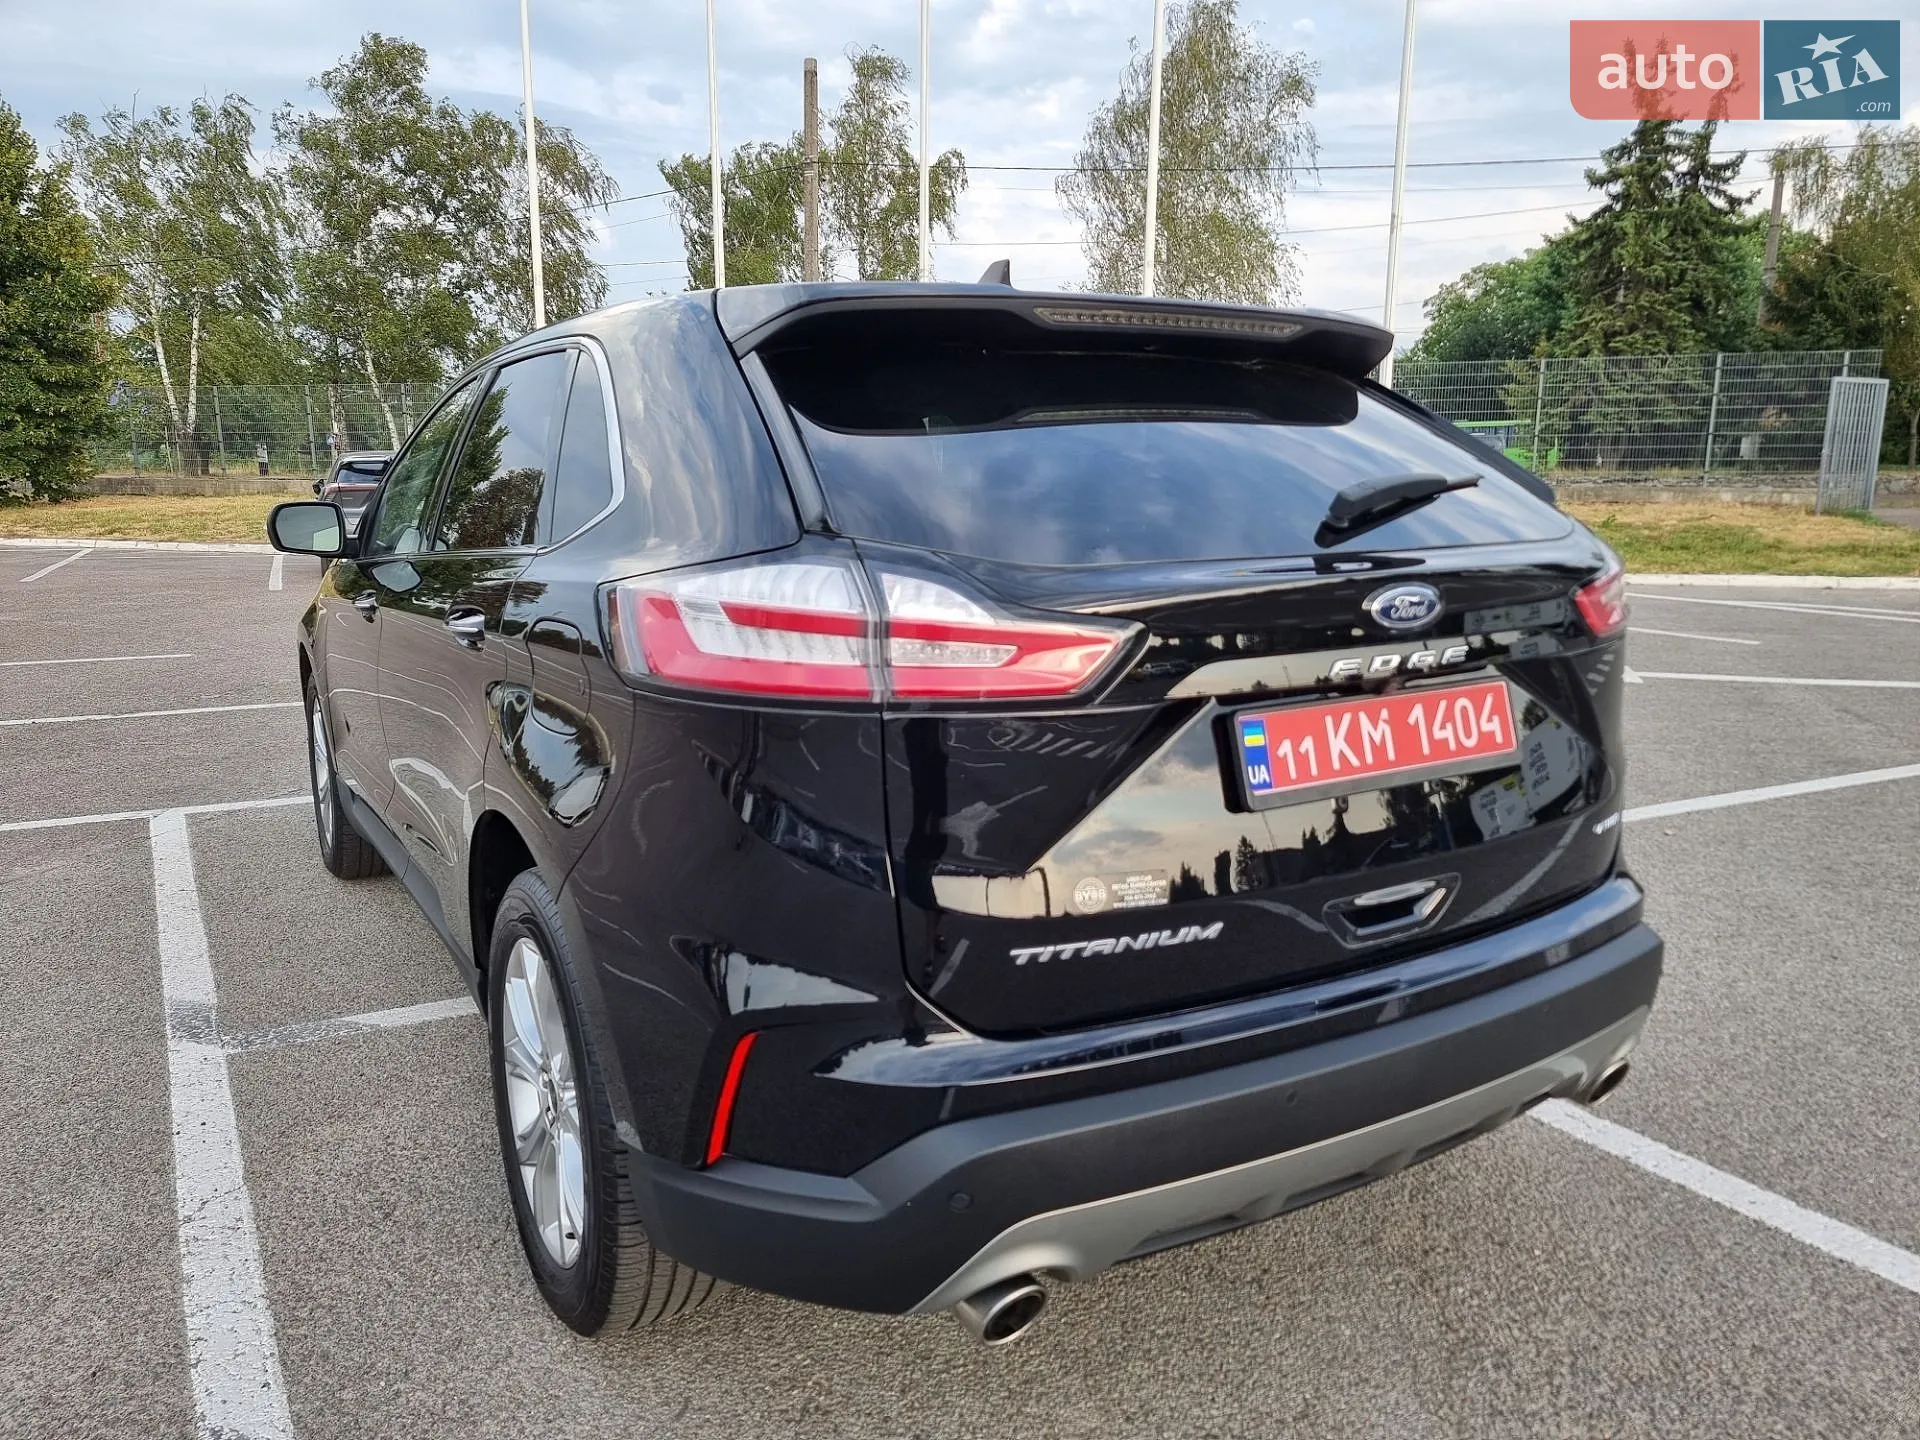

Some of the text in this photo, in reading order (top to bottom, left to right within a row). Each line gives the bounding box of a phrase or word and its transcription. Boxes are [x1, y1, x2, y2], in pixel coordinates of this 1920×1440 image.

[1390, 595, 1429, 619] Ford
[1328, 645, 1470, 678] EDGE
[1276, 693, 1504, 780] 11 KM 1404
[1248, 765, 1271, 785] UA
[1009, 921, 1225, 966] TITANIUM
